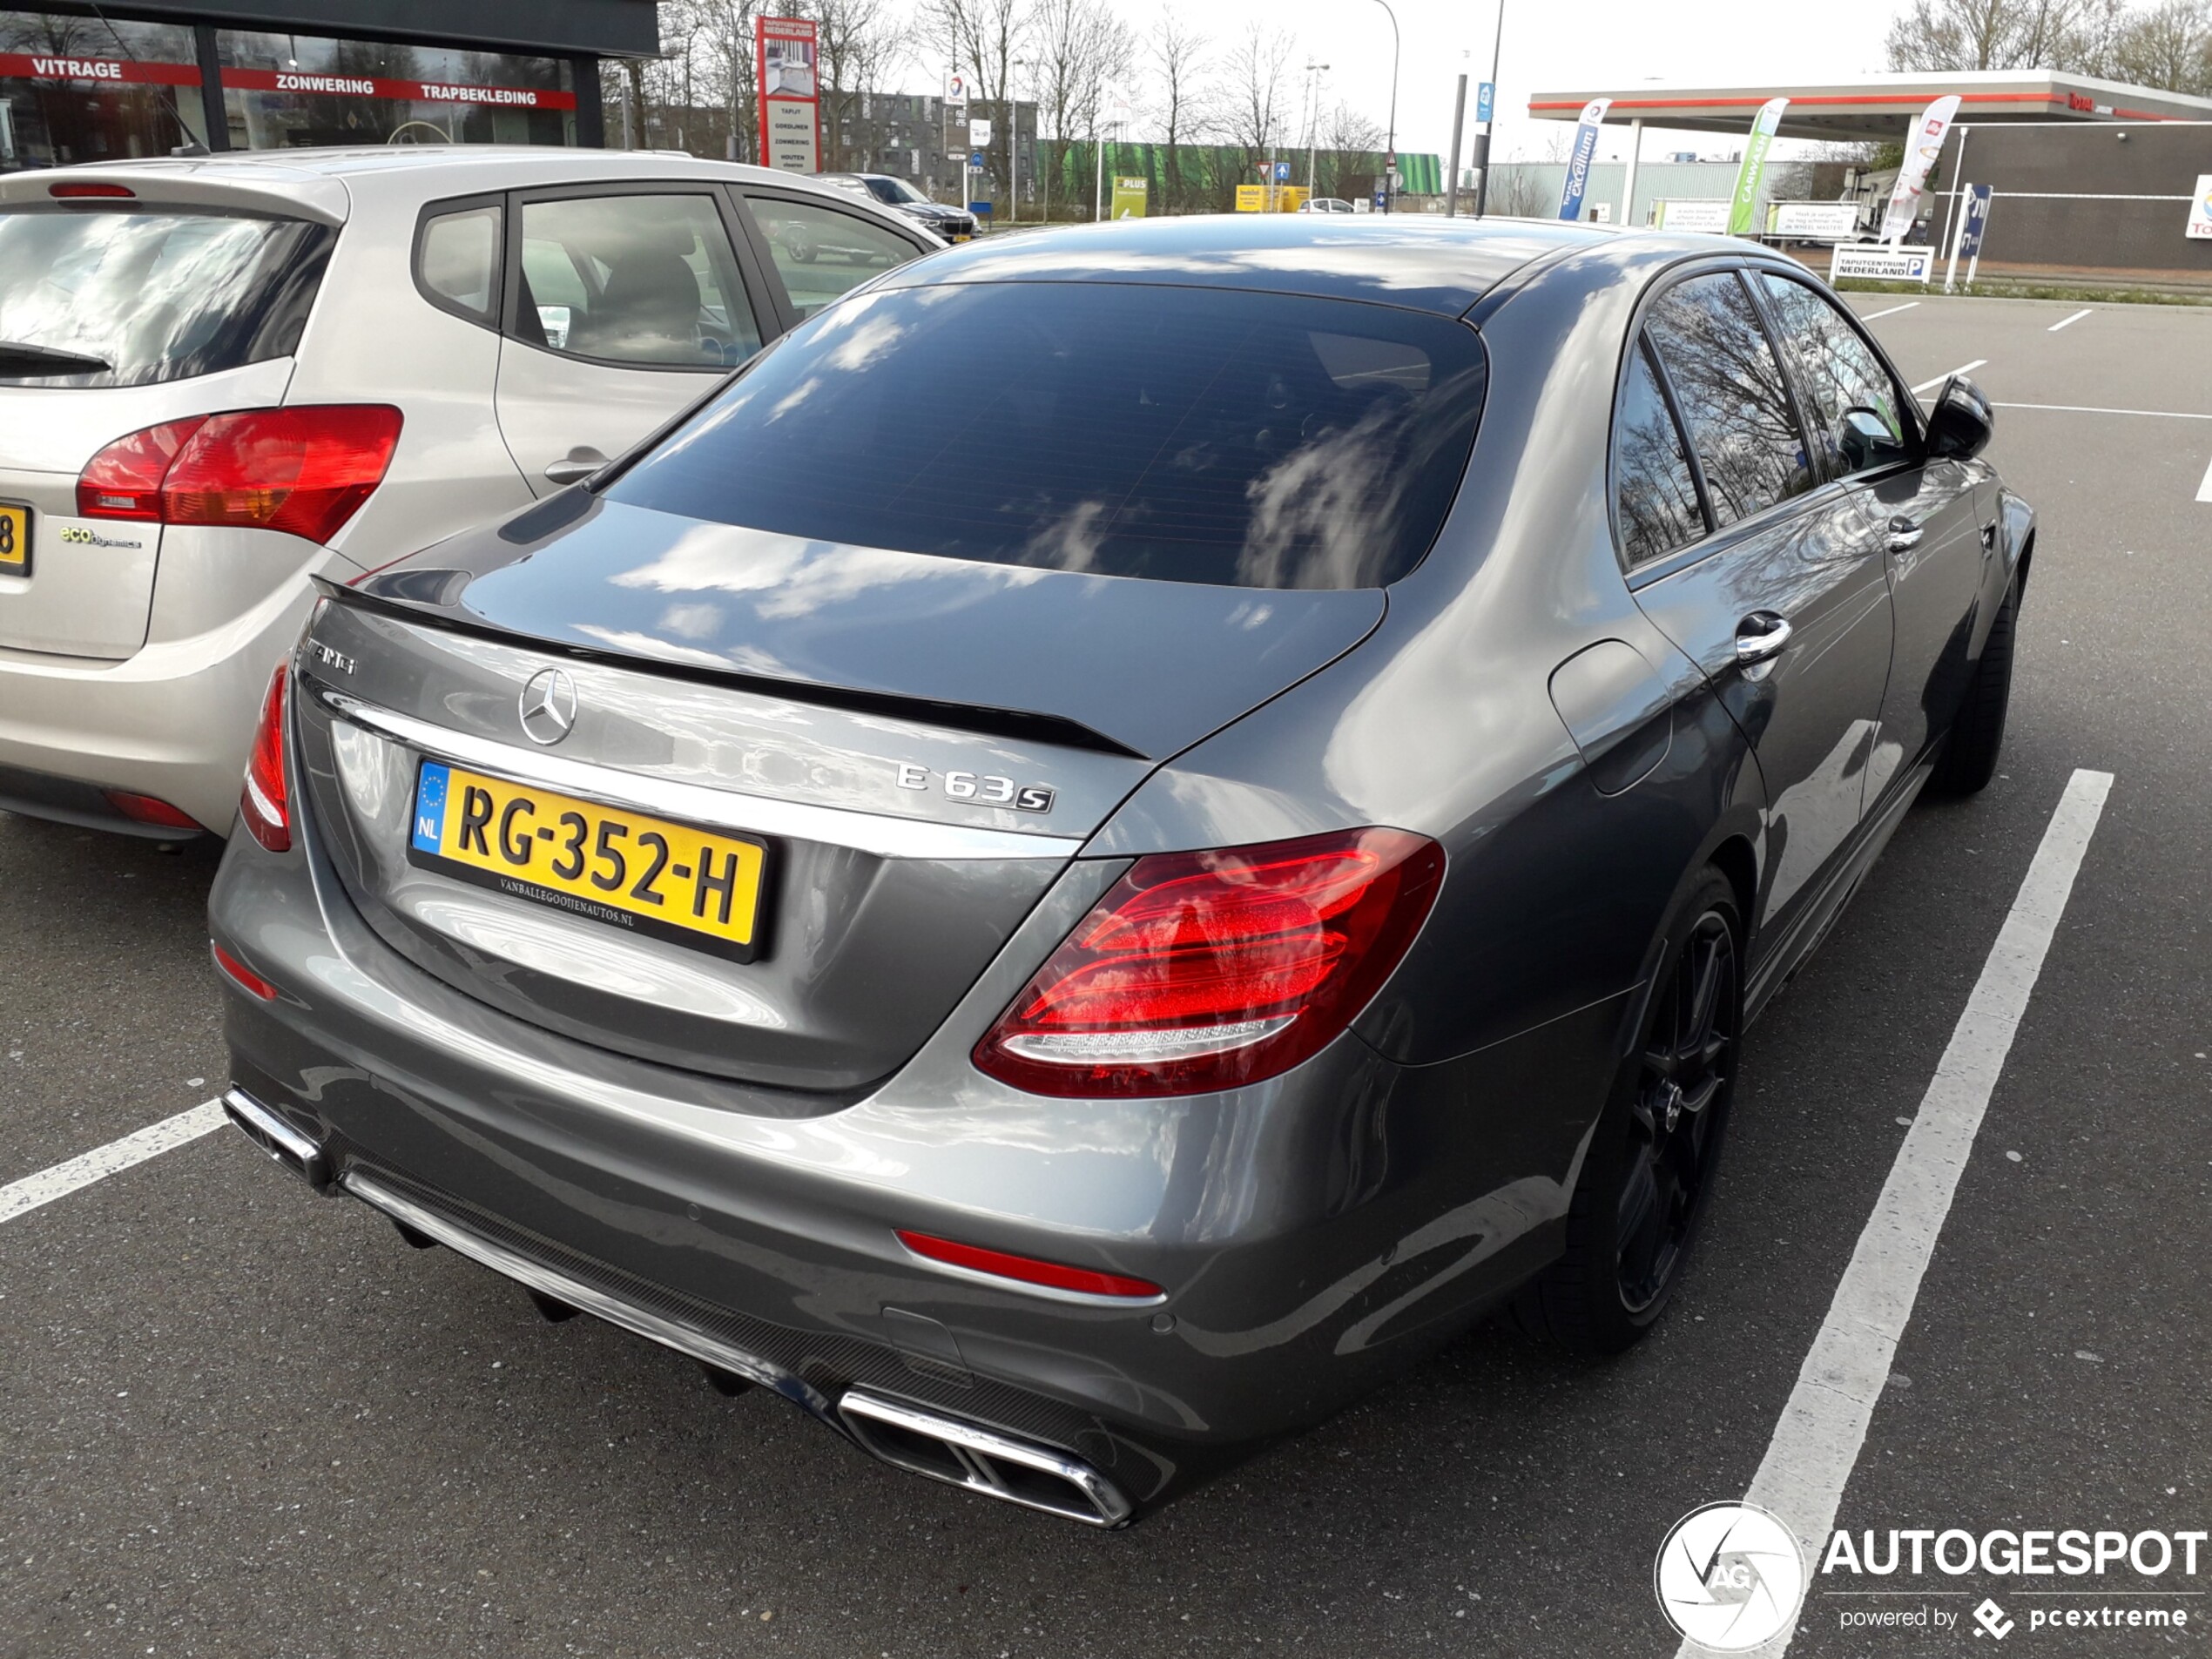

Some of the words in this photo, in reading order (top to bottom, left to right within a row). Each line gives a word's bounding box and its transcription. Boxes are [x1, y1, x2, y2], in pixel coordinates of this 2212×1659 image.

[32, 58, 122, 78] VITRAGE
[275, 75, 374, 94] ZONWERING
[421, 84, 537, 105] TRAPBEKLEDING
[1571, 131, 1595, 197] excellium
[1742, 134, 1769, 203] CARWASH
[1123, 179, 1147, 189] PLUS
[1562, 179, 1574, 206] TOTAL
[1839, 266, 1905, 276] NEDERLAND
[896, 763, 930, 791] E
[418, 816, 438, 840] NL
[457, 785, 738, 925] RG-352-H
[500, 878, 635, 927] VANBALLEGOOIJENAUTOS.NL
